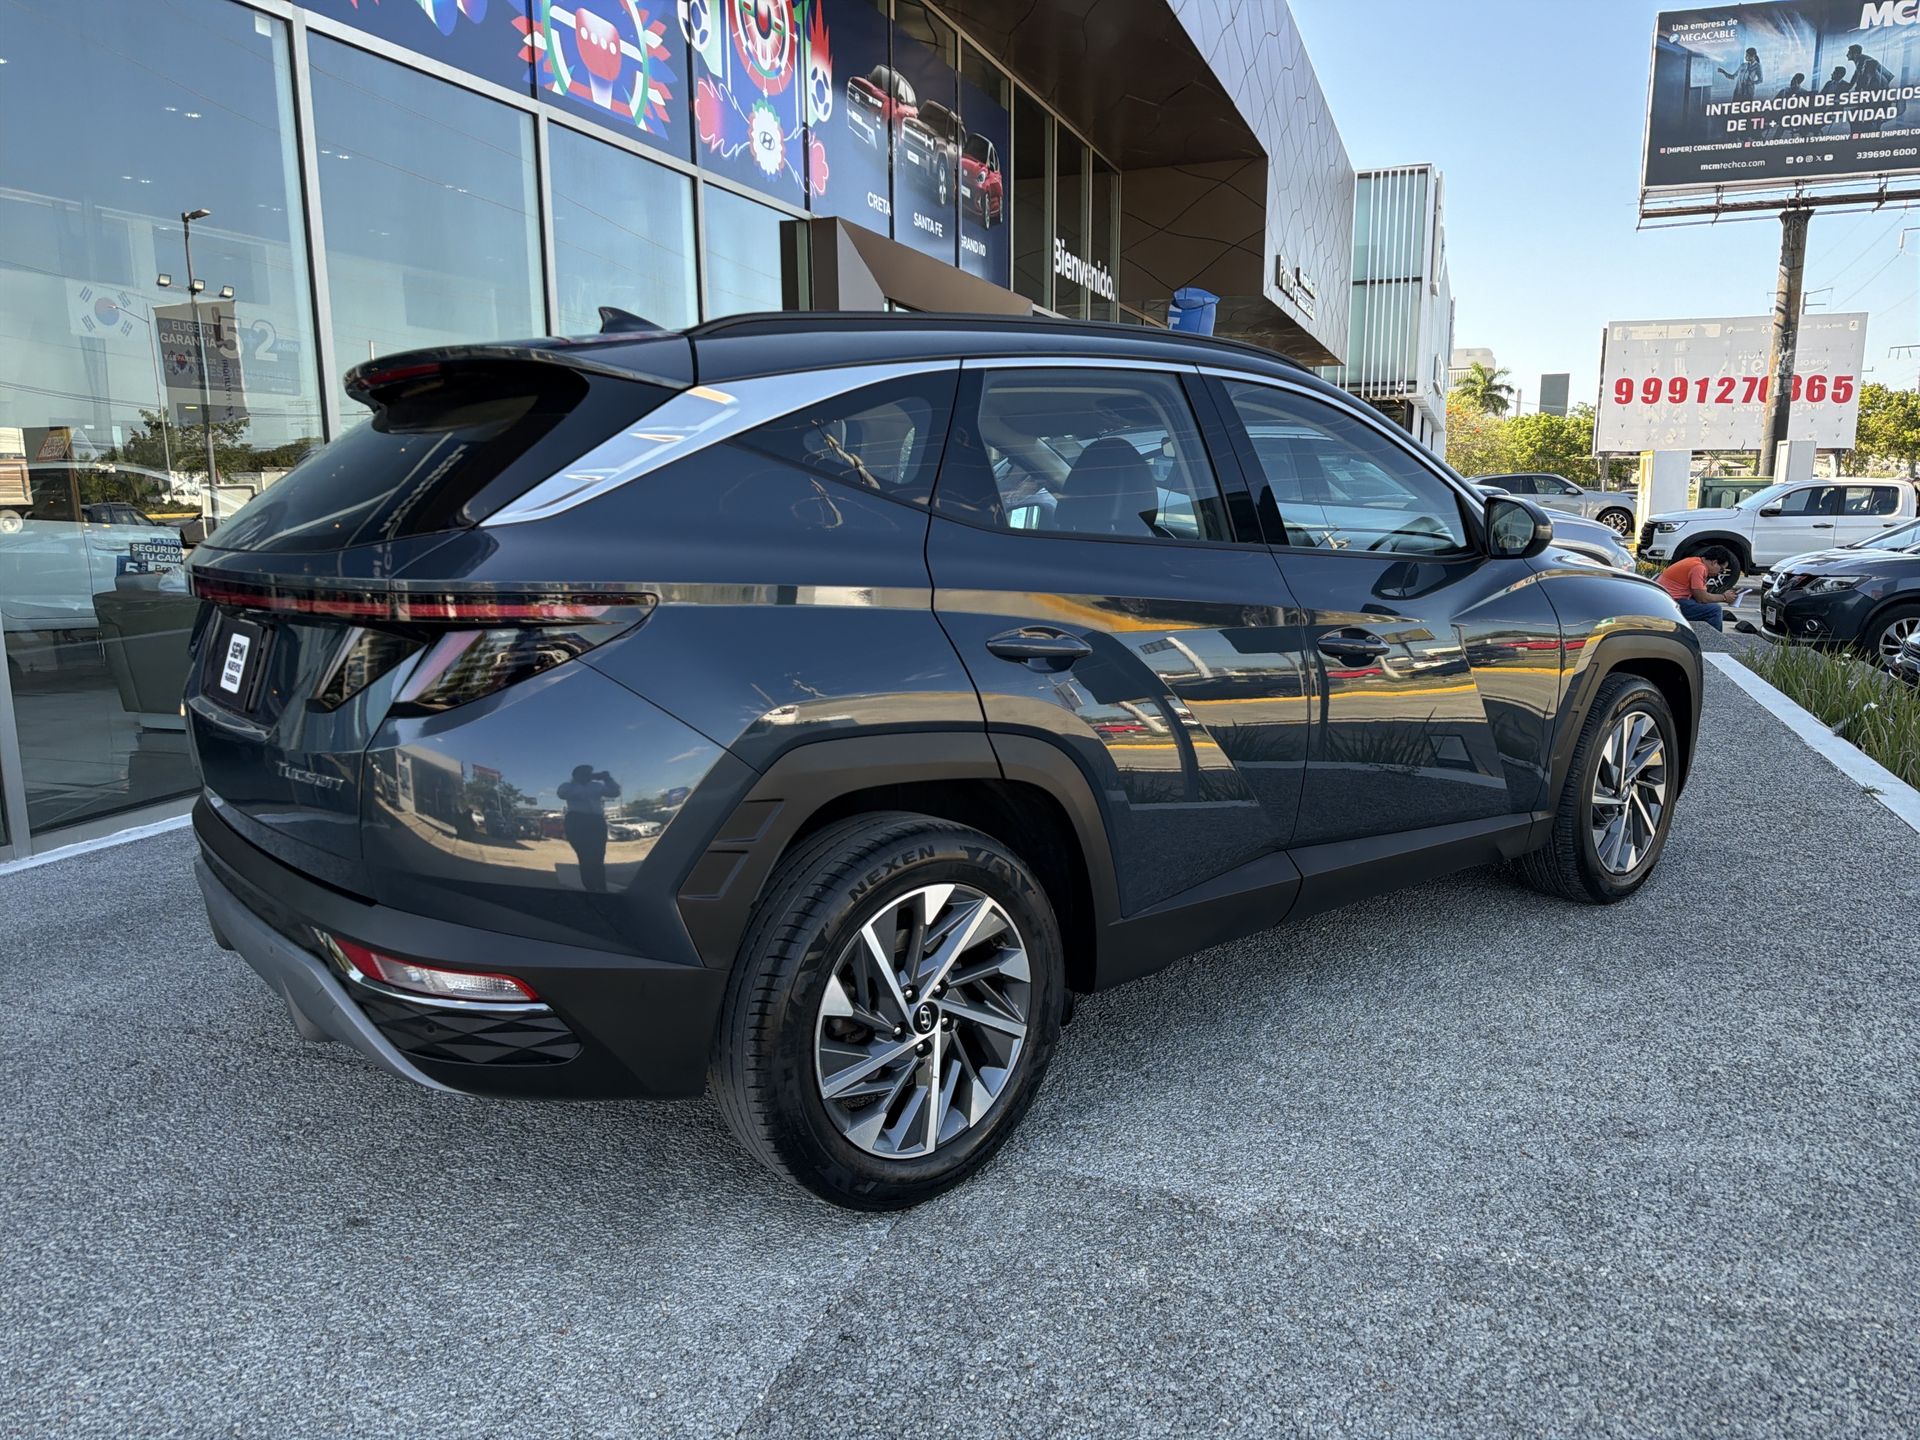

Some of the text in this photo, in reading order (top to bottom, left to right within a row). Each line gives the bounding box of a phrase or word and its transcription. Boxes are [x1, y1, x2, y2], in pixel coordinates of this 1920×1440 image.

[1672, 18, 1738, 31] Una empresa de
[1860, 0, 1920, 29] MC
[1680, 29, 1736, 42] MEGACABLE
[1706, 86, 1920, 116] INTEGRACIÓN DE SERVICIOS
[1726, 106, 1898, 132] DE TI + CONECTIVIDAD
[1693, 143, 1742, 152] CONECTIVIDAD
[1752, 136, 1805, 147] COLABORACIÓN
[1810, 134, 1850, 143] SYMPHONY
[1892, 147, 1917, 156] 6000
[1701, 160, 1766, 170] mcmtechco.com
[867, 192, 891, 216] CRETA
[913, 212, 943, 237] SANTA FE
[141, 552, 154, 561] TU
[847, 844, 936, 901] NEXEN
